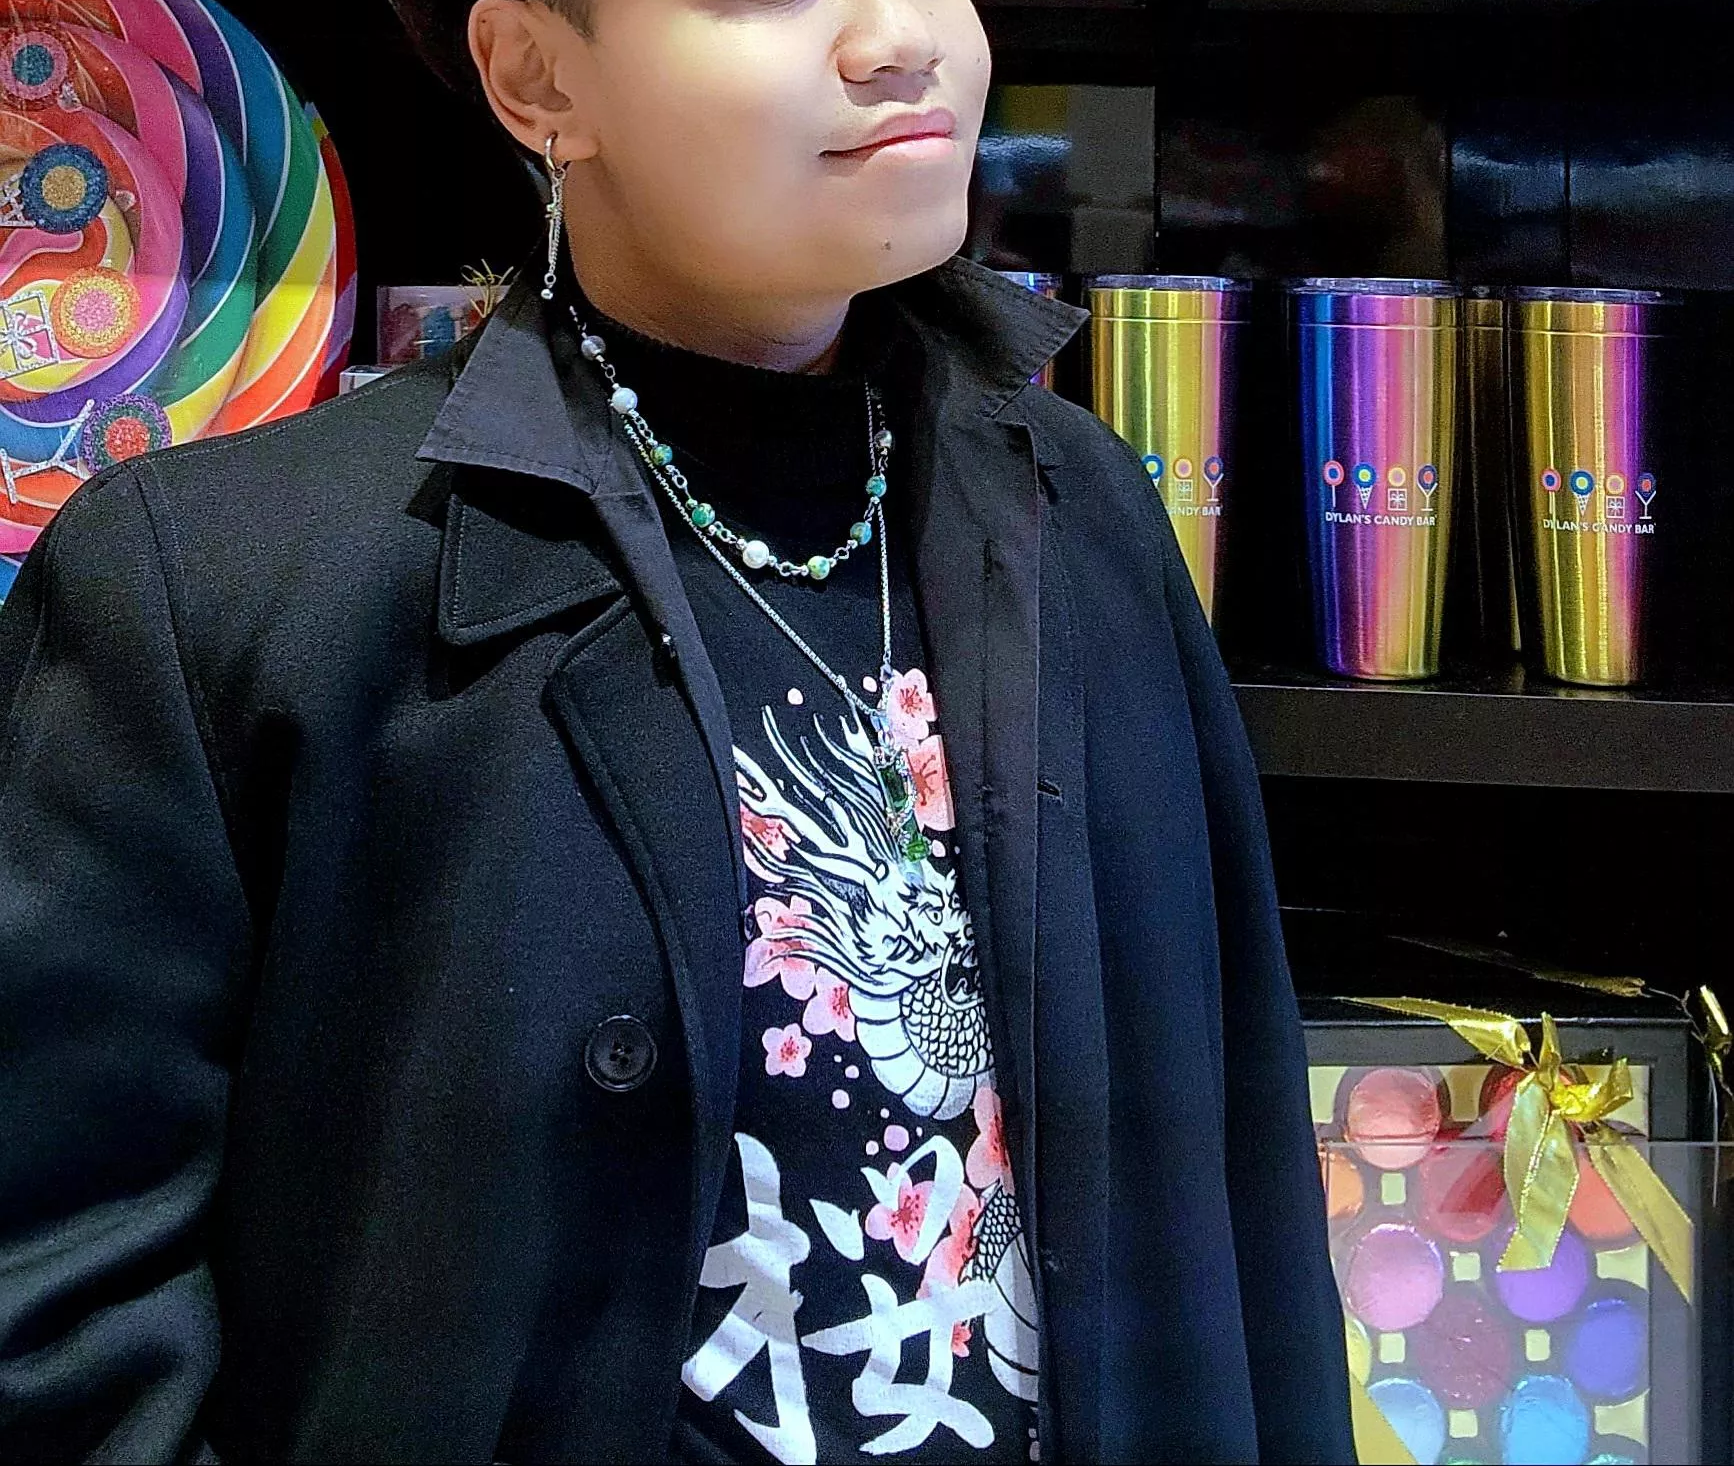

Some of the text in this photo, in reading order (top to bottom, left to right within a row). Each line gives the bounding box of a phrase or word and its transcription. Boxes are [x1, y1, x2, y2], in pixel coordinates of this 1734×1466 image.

[1166, 506, 1221, 516] ANDY BAR
[1325, 511, 1436, 526] DYLAN'S CANDY BAR
[1592, 521, 1633, 534] CANDY
[1634, 524, 1655, 534] BAR
